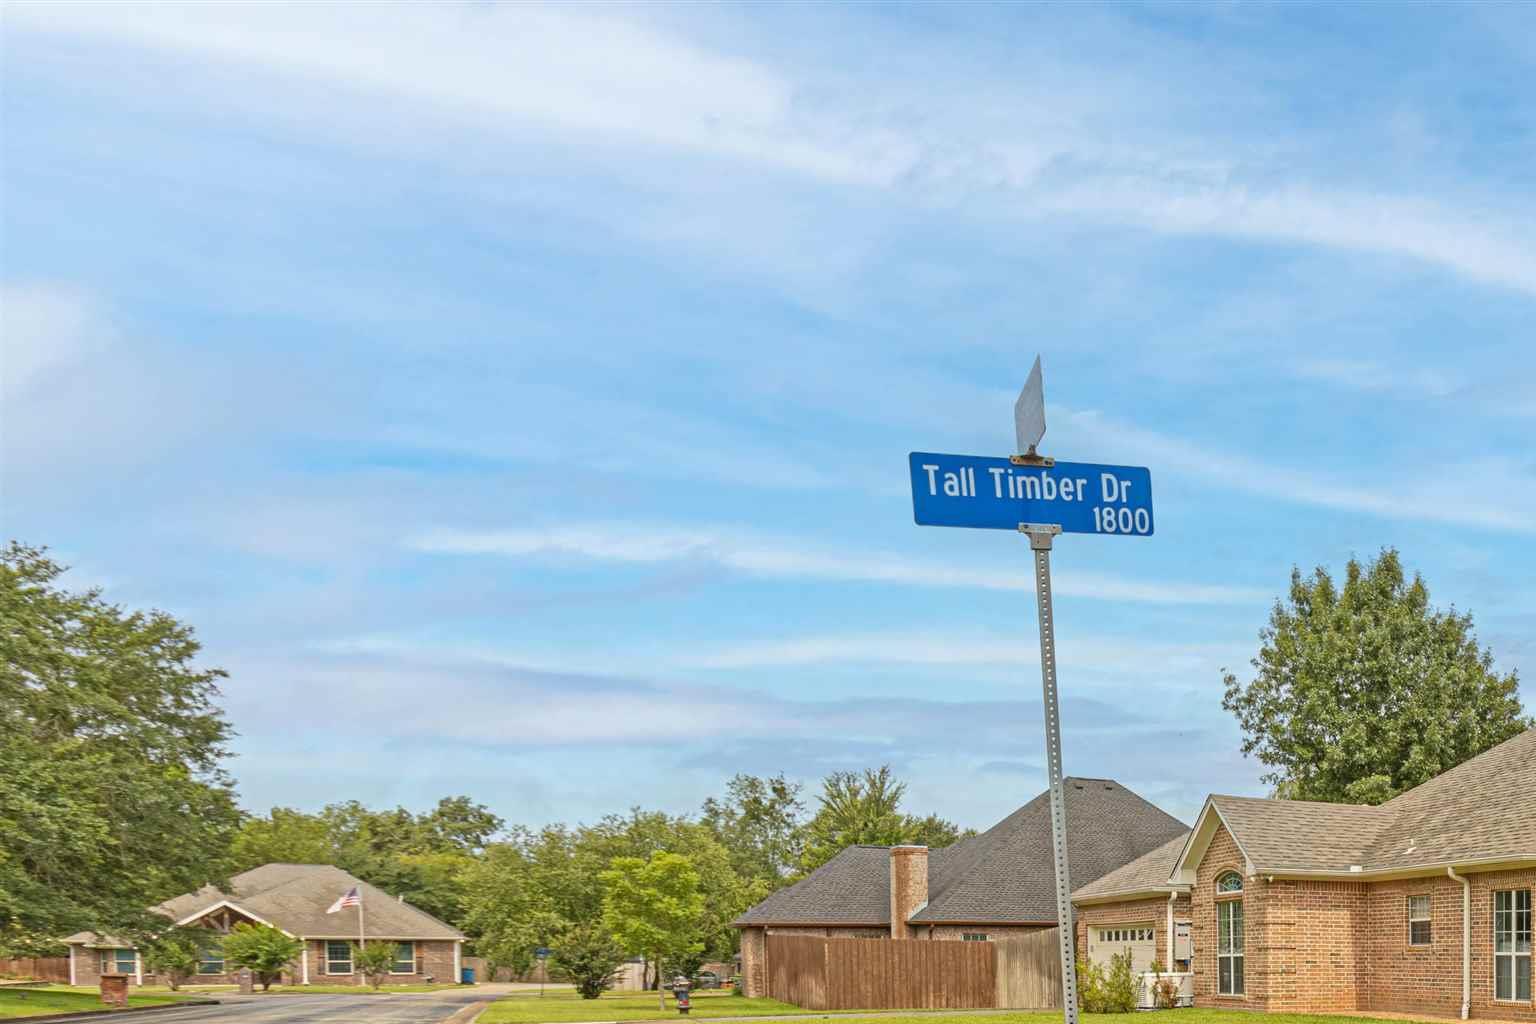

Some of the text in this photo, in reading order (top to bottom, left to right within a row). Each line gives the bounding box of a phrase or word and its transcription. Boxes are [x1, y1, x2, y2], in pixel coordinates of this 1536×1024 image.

[922, 464, 1132, 504] Tall Timber Dr
[1092, 506, 1150, 534] 1800
